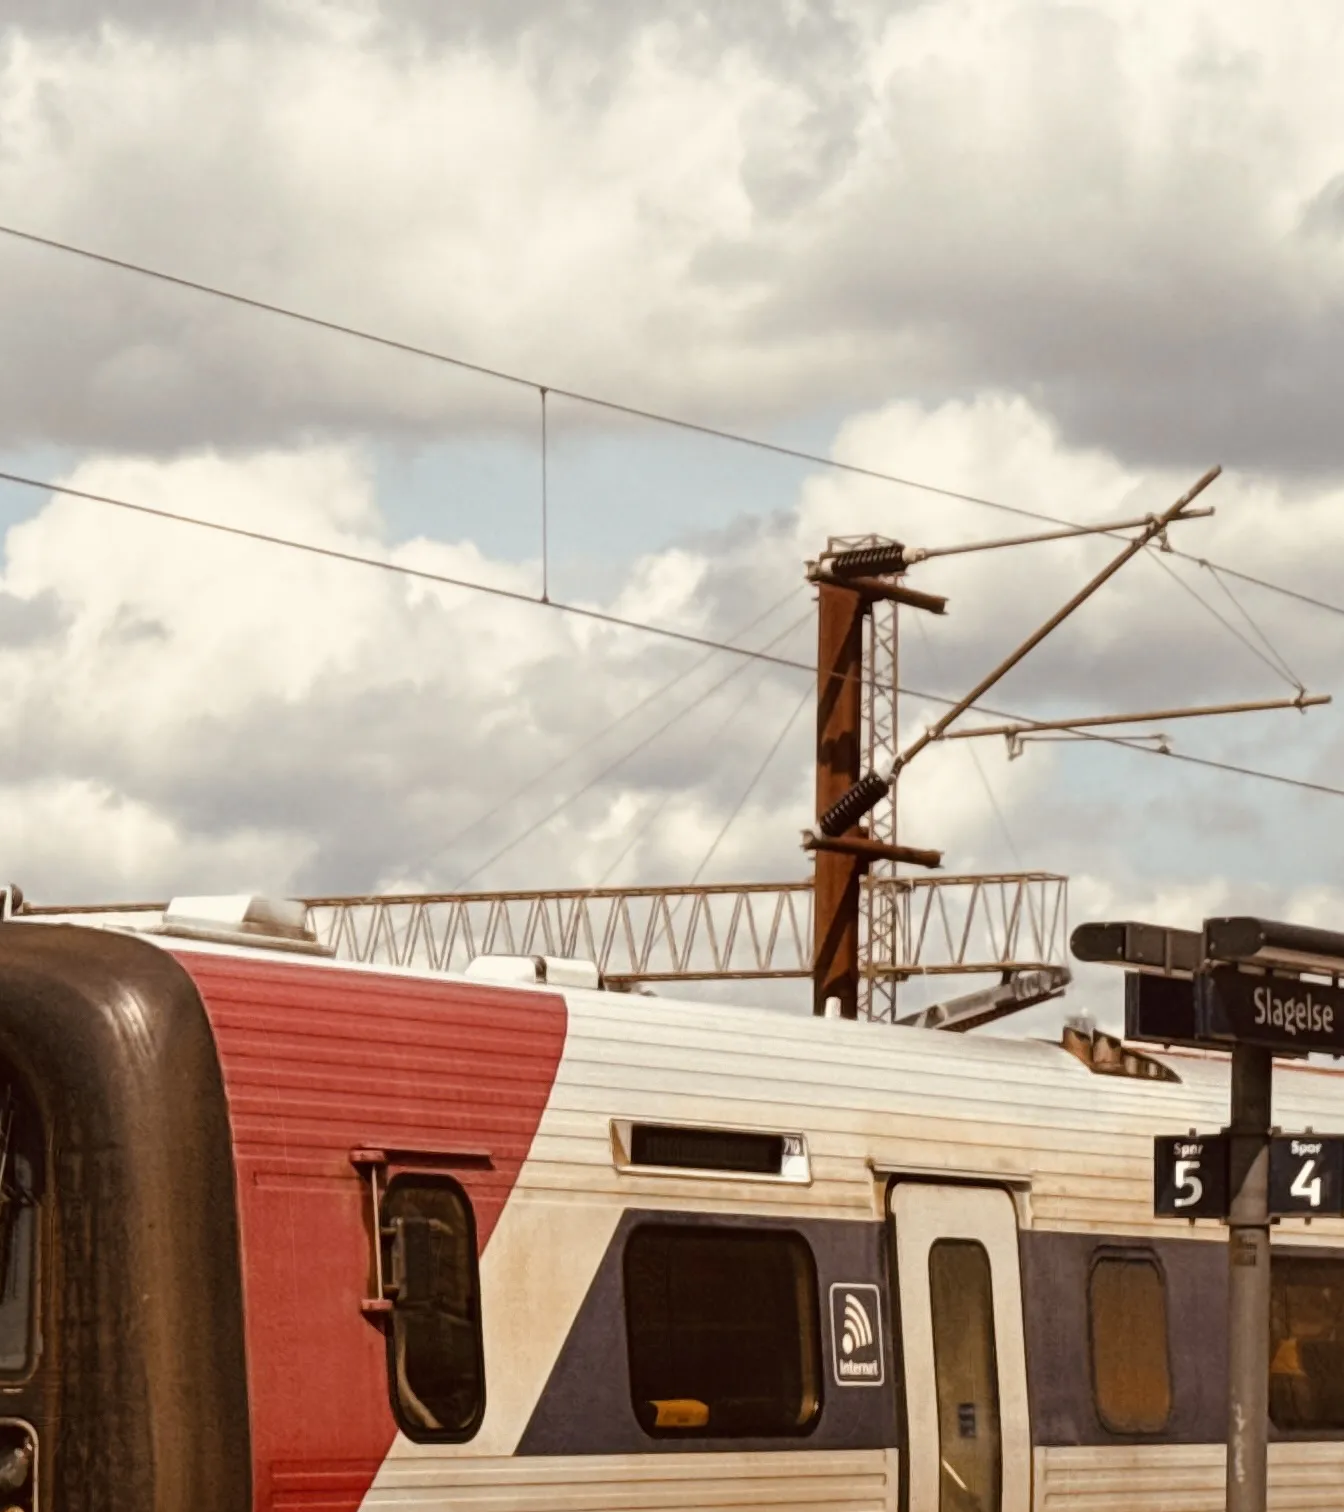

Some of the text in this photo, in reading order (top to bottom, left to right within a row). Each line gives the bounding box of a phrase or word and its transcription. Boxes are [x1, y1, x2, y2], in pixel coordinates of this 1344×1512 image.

[1253, 986, 1335, 1035] Slagelse
[1290, 1140, 1323, 1157] Spor
[1173, 1160, 1203, 1208] 5
[1289, 1159, 1323, 1207] 4
